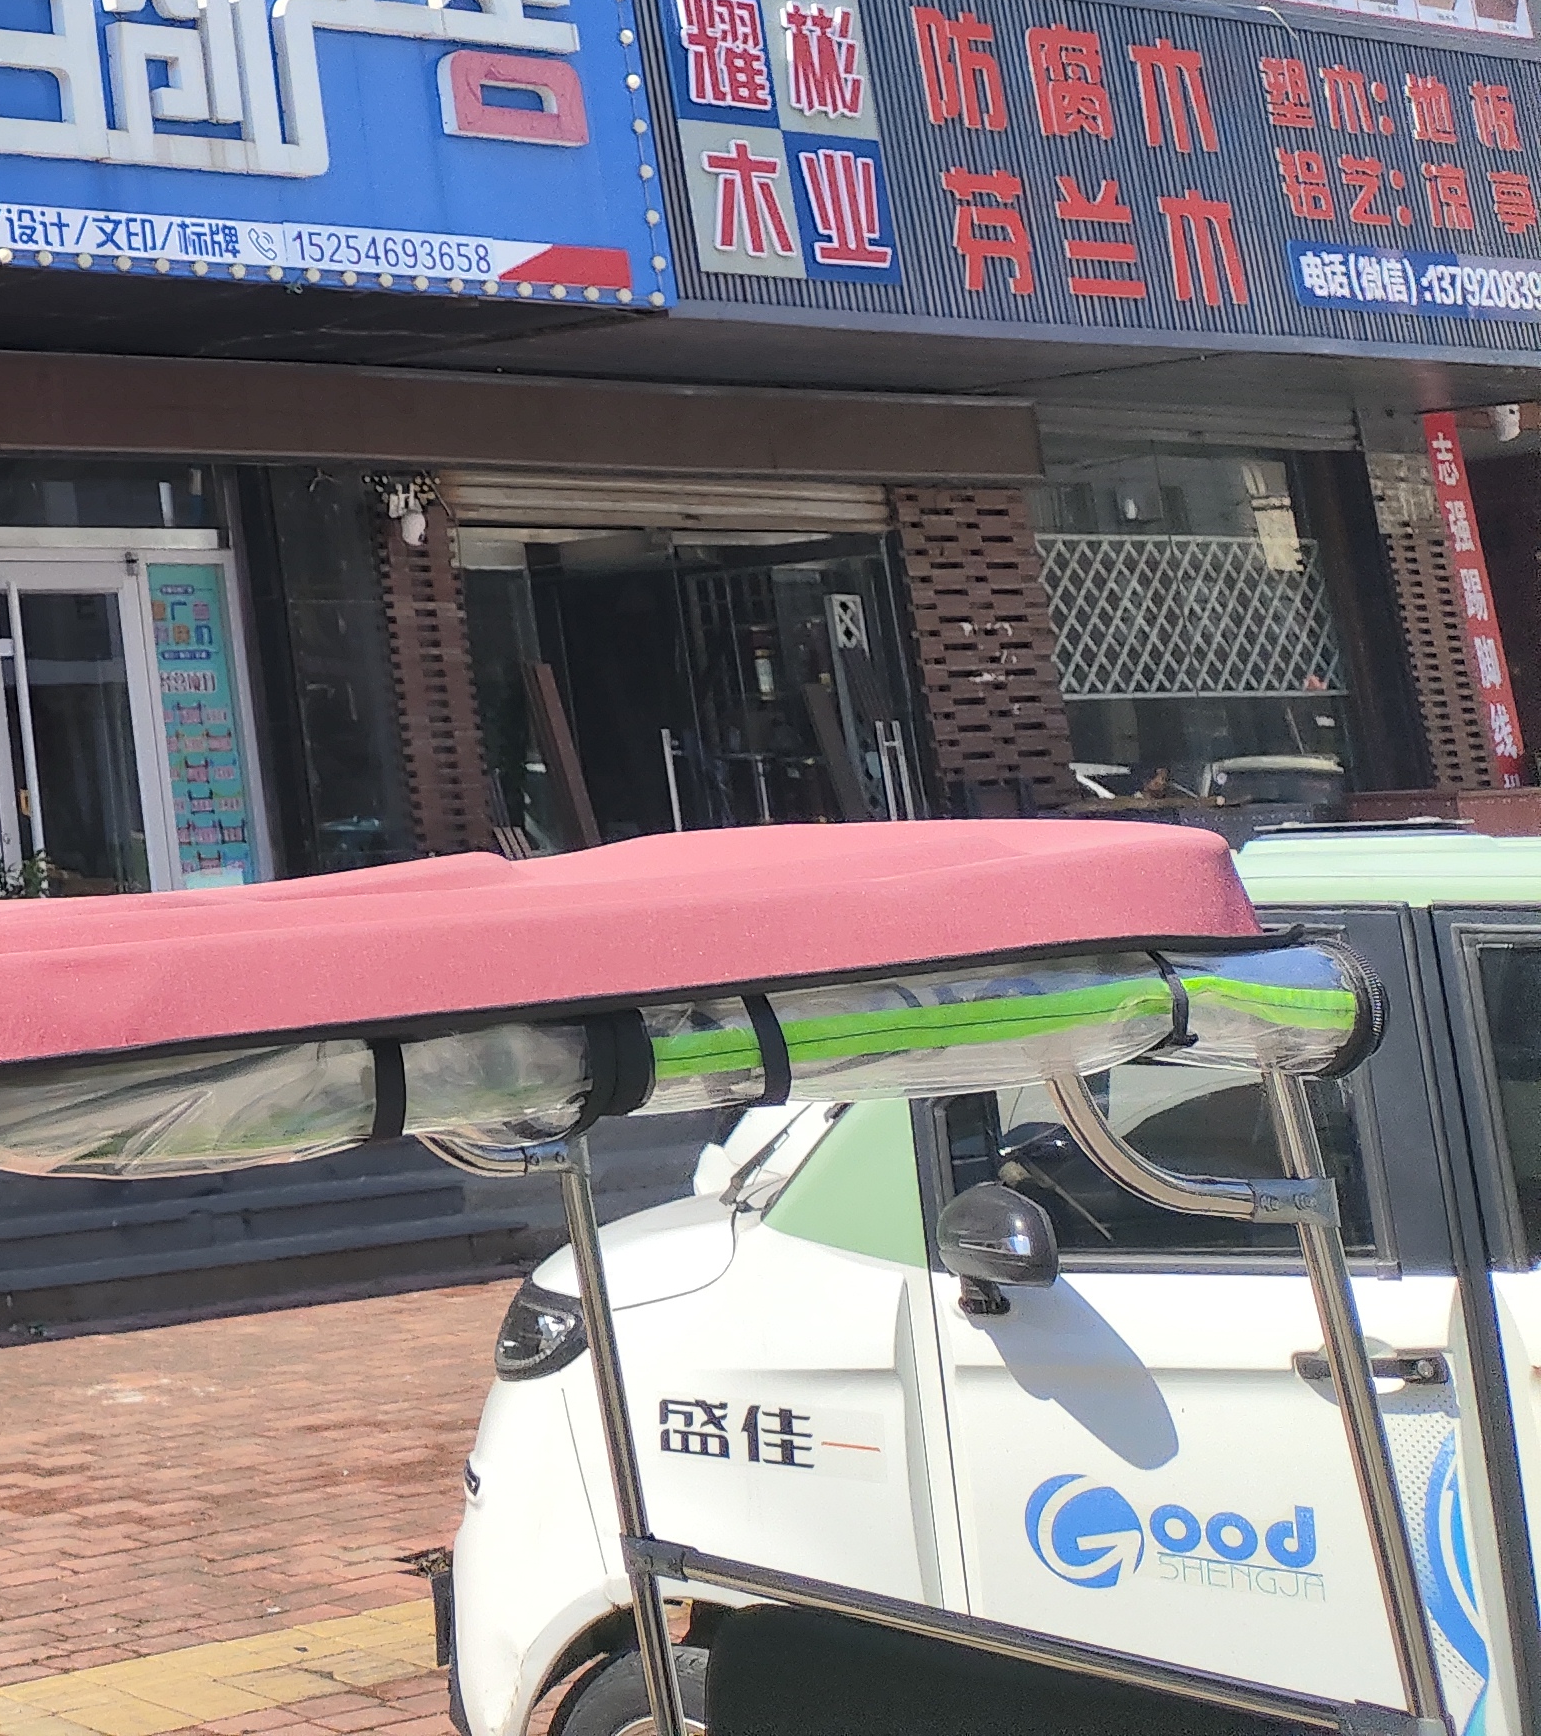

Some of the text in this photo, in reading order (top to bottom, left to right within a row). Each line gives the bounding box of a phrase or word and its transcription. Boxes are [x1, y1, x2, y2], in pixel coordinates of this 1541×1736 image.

[911, 5, 1220, 155] 防腐木
[291, 228, 492, 277] 15254693658
[701, 139, 894, 269] 木业
[941, 166, 1251, 307] 芬兰木
[657, 1396, 816, 1470] 盛佳
[1024, 1472, 1318, 1590] Good
